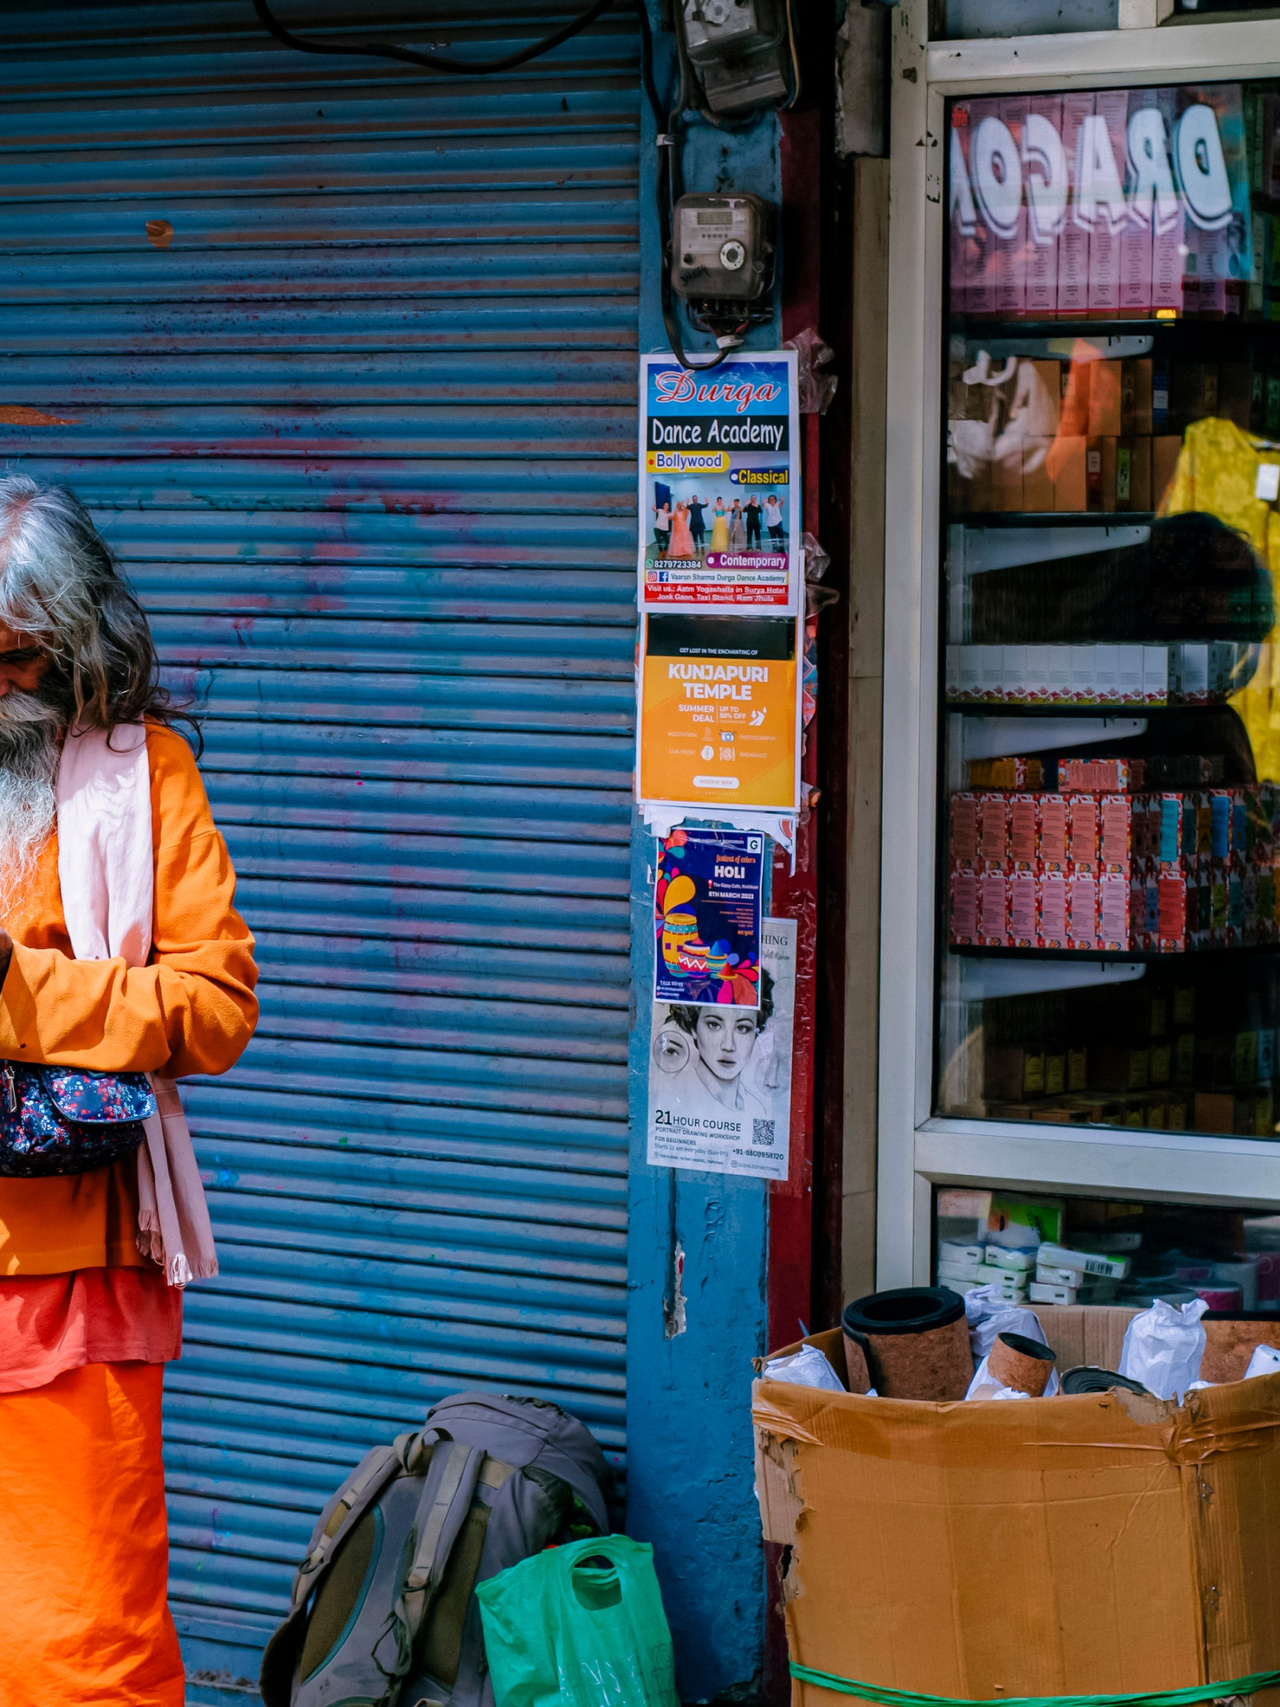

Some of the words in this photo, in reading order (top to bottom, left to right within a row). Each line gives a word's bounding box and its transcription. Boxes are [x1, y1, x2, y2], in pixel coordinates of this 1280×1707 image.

[655, 370, 781, 413] Durga
[653, 418, 702, 445] Dance
[707, 417, 784, 451] Academy
[657, 454, 722, 470] Bollywood
[738, 470, 788, 484] Classical
[654, 560, 702, 569] 8279723384
[720, 554, 786, 569] Contemporary
[717, 574, 735, 583] Durga
[757, 575, 786, 584] Academy
[668, 663, 769, 683] KUNJAPURI
[683, 682, 752, 701] TEMPLE
[678, 704, 715, 713] SUMMER
[692, 714, 715, 723] DEAL
[750, 840, 759, 850] G
[714, 865, 746, 879] HOLI
[655, 1110, 672, 1126] 21
[673, 1116, 700, 1128] HOUR
[703, 1119, 741, 1132] COURSE
[655, 1127, 681, 1135] PORTRAIT
[682, 1129, 708, 1138] DRAWING
[708, 1133, 741, 1141] WORKSHOP
[666, 1137, 696, 1146] BEGINNERS
